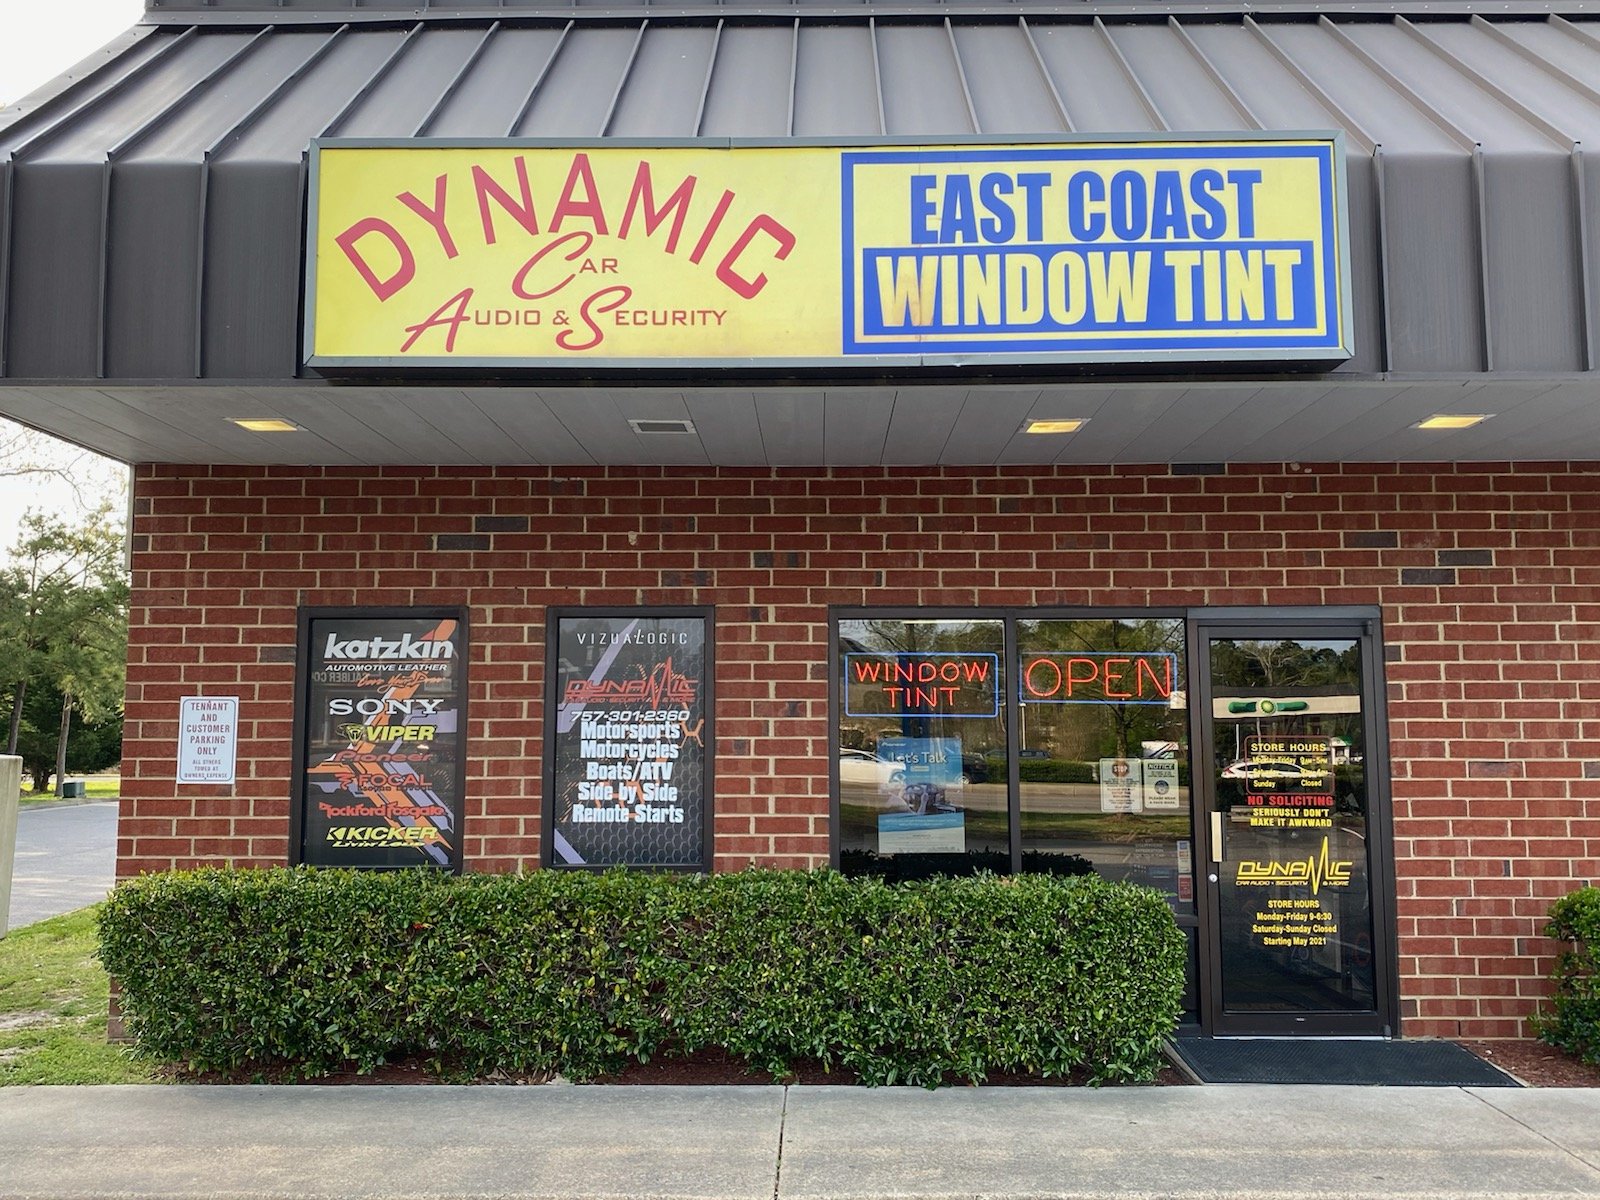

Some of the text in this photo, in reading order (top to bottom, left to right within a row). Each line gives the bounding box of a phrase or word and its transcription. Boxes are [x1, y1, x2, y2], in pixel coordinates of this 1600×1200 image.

[910, 169, 1262, 245] EAST COAST
[335, 153, 797, 303] DYNAMIC
[511, 231, 619, 301] CAR
[875, 249, 1302, 328] WINDOW TINT
[400, 285, 728, 353] AUDIO & SECURITY
[576, 628, 689, 645] VIZUALOGIC
[323, 633, 454, 660] katzkin
[325, 664, 448, 672] AUTOMOTIVE LEATHER
[855, 661, 989, 683] WINDOW
[564, 655, 699, 710] DYNAMIC
[1025, 657, 1173, 698] OPEN
[882, 686, 961, 710] TINT
[191, 702, 228, 711] TENNANT
[329, 698, 445, 716] SONY
[200, 713, 218, 722] AND
[186, 724, 230, 733] CUSTOMER
[366, 725, 437, 741] VIPER
[580, 721, 681, 741] Motorsports
[190, 735, 226, 744] PARKING
[196, 746, 218, 755] ONLY
[579, 740, 679, 761] Motorcycles
[1250, 742, 1327, 752] STORE HOURS
[333, 750, 432, 763] Pioneer
[890, 752, 948, 764] Let's Talk
[586, 761, 674, 782] Boats/ATV
[1113, 765, 1128, 773] STOP
[358, 773, 433, 786] FOCAL
[1253, 779, 1322, 789] Sunday Closed
[577, 781, 678, 804] Side by Side
[1247, 795, 1334, 806] NO SOLICITING
[572, 804, 684, 823] Remote Starts
[1253, 808, 1330, 817] SERIOUSLY DON'T
[1250, 818, 1332, 827] MAKE IT AWKWARD
[345, 827, 438, 841] KICKER
[1236, 835, 1353, 895] DYNAMIC
[1267, 900, 1320, 909] STORE HOURS
[1256, 912, 1333, 922] Monday-Friday 9-6:30
[1252, 924, 1338, 934] Saturday-Sunday Closed
[1263, 936, 1327, 946] Starting May 2021
